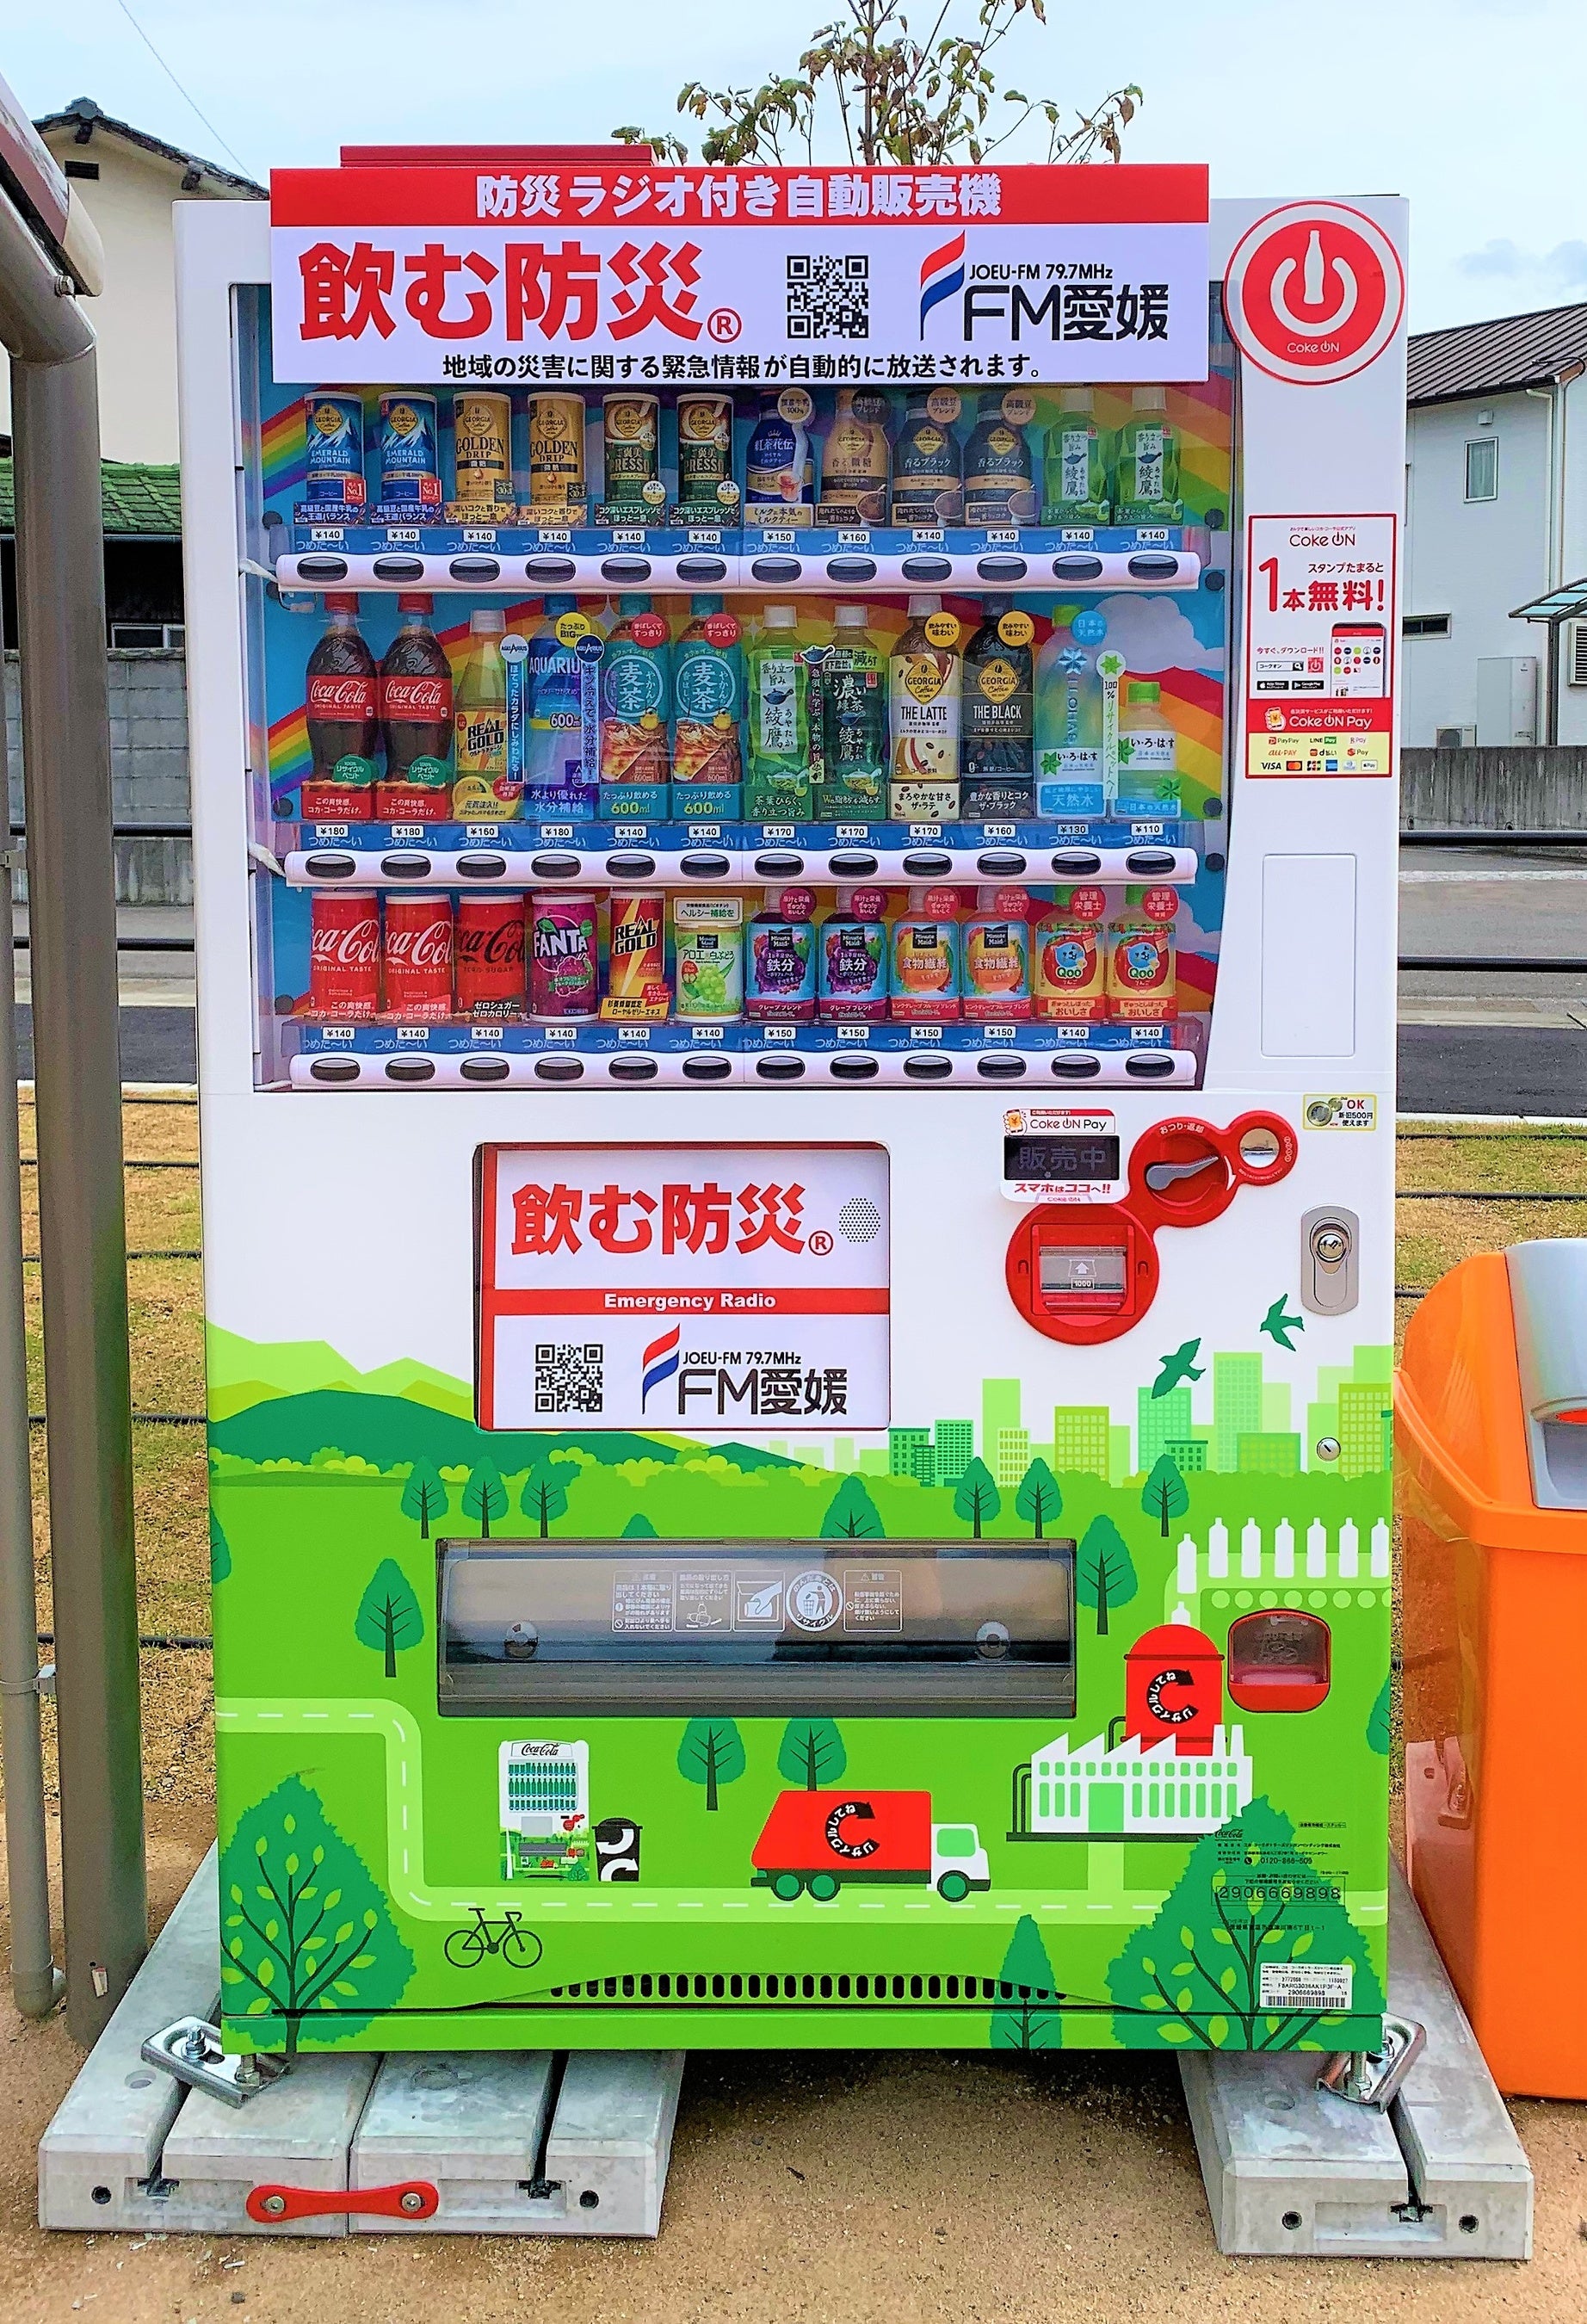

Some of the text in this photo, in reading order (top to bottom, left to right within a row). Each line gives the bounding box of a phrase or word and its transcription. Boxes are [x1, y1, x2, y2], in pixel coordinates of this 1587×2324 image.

[476, 174, 1002, 218] 防災ラジオ付き自動販売機
[969, 264, 1112, 280] JOEU-FM 79.7MHz
[964, 284, 1168, 342] FM愛媛
[1288, 343, 1318, 353] Coke
[443, 354, 1040, 379] 地域の災害に関する緊急情報が自動的に放送されます。
[456, 437, 504, 454] GOLDEN
[755, 439, 794, 451] 紅茶花伝
[905, 458, 951, 468] 香るブラック
[347, 484, 362, 496] No.1
[1290, 532, 1355, 547] Coke ON
[1308, 563, 1384, 573] スタンプたまると
[529, 658, 580, 673] AQUARIU
[619, 663, 644, 711] 麦茶
[692, 662, 719, 711] 麦茶
[833, 675, 867, 699] 濃い
[907, 677, 942, 686] GEORGIA
[981, 677, 1016, 685] GEORGIA
[311, 679, 367, 705] Coca-Cola
[386, 679, 442, 706] Coca-Cola
[901, 706, 947, 720] THE LATTE
[973, 705, 1022, 719] THE BLACK
[467, 718, 503, 739] REAL
[1289, 714, 1372, 730] Coke ON Pay
[467, 733, 503, 751] GOLD
[531, 790, 587, 800] 水より優れた
[755, 796, 802, 805] 茶葉ひらく、
[898, 793, 951, 801] まろやかな甘さ
[970, 792, 1029, 802] 豊かな香りとコク
[1053, 794, 1093, 807] 天然水
[535, 801, 584, 813] 水分補給
[750, 807, 805, 817] 香り立つ旨み
[1075, 901, 1102, 911] 栄養士
[681, 909, 734, 918] ヘルシー補給を
[615, 917, 656, 938] REAL
[534, 928, 588, 957] FANTA
[615, 934, 657, 955] GOLD
[767, 959, 794, 972] 鉄分
[839, 959, 868, 972] 鉄分
[1057, 967, 1082, 979] Qoo
[1129, 967, 1154, 979] Qoo
[1347, 1100, 1364, 1109] OK
[1030, 1117, 1107, 1131] Coke ON Pay
[1019, 1147, 1106, 1171] 販売中
[605, 1293, 775, 1310] Emergency Radio
[682, 1351, 800, 1365] JOEU-FM 79.7MHz
[678, 1369, 847, 1415] FM愛媛
[796, 1613, 834, 1628] リサイクル
[1149, 1672, 1193, 1722] リサイクルしてね
[522, 1743, 559, 1756] Coca-Cola
[827, 1804, 874, 1857] リサイクルしてね
[1220, 1887, 1340, 1900] 2906669898
